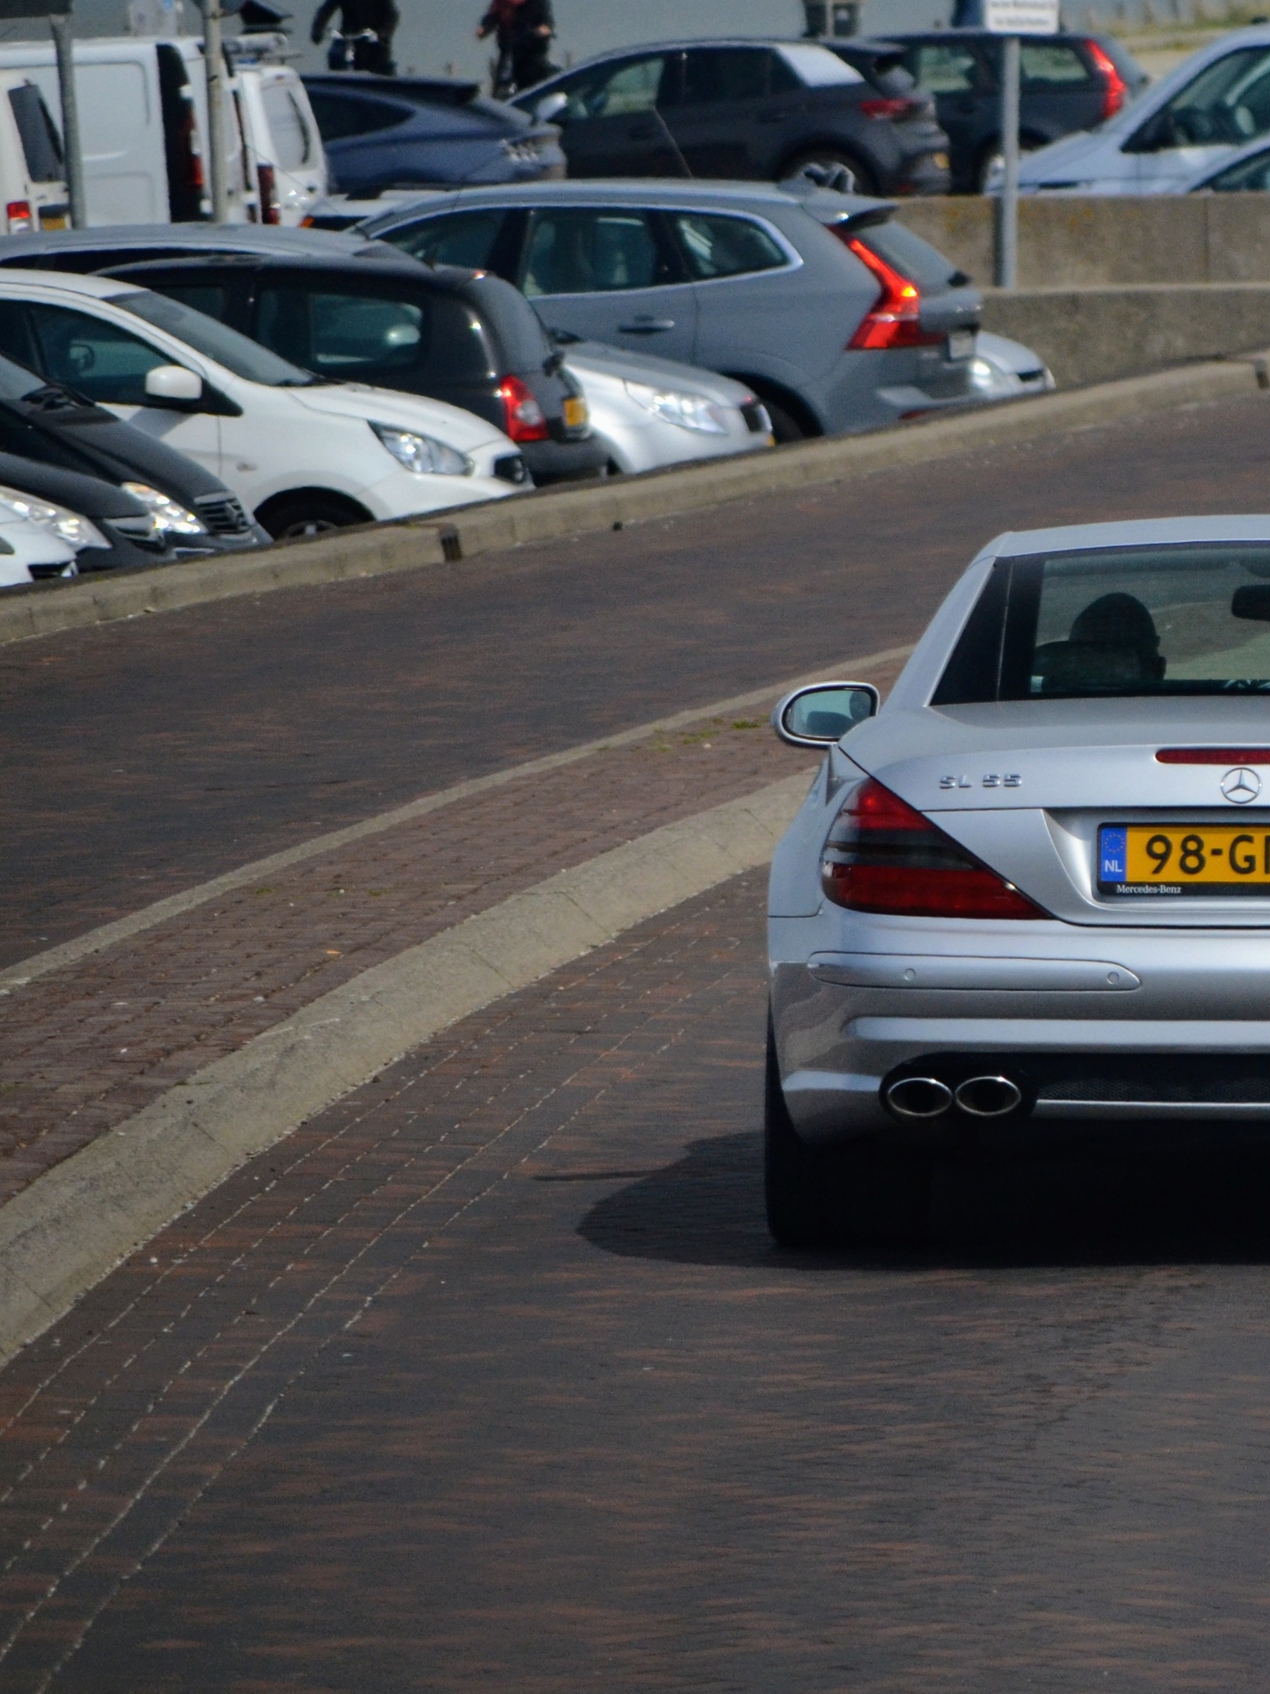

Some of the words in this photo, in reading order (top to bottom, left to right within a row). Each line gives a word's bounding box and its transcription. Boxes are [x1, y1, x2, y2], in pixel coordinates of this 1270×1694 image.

[939, 774, 972, 789] SL
[982, 774, 1022, 788] 55
[1104, 860, 1123, 873] NL
[1116, 884, 1182, 894] Mercedes-Benz
